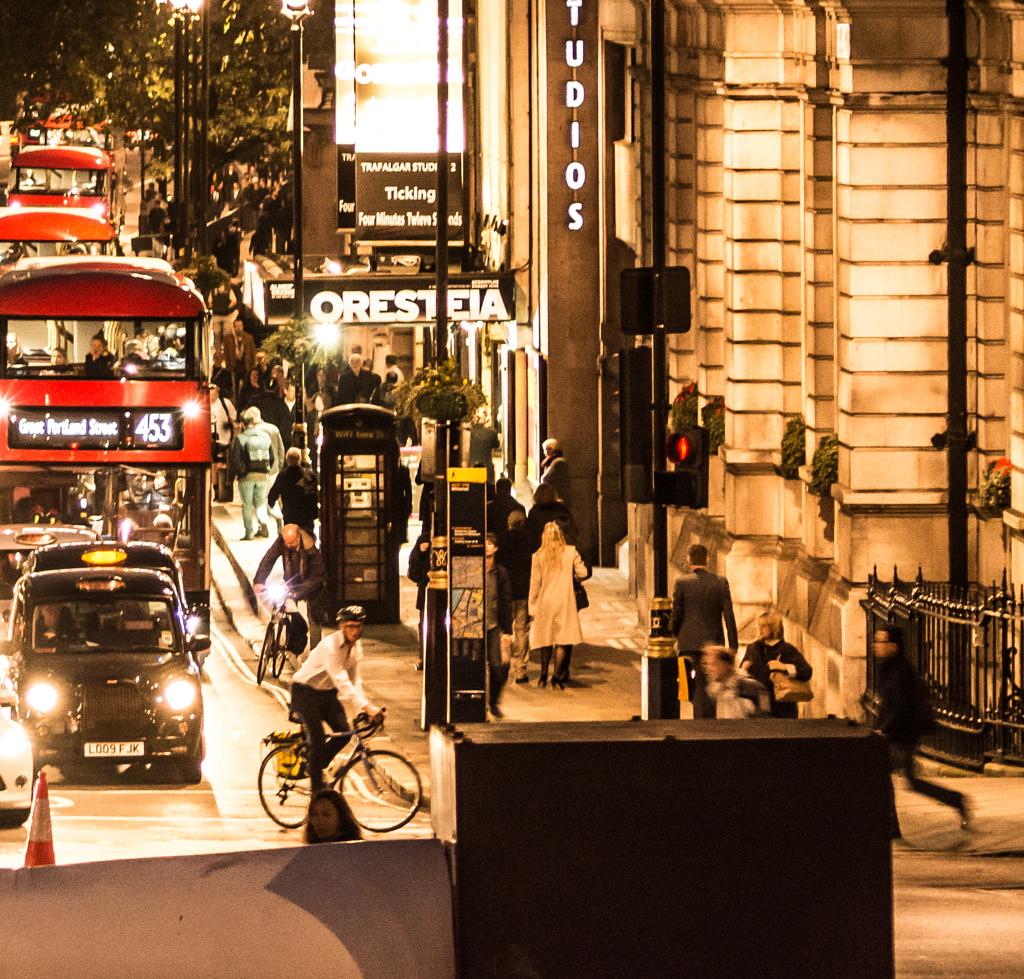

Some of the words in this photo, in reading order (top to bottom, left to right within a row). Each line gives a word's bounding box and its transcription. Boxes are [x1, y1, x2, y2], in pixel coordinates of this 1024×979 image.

[361, 162, 411, 173] TRAFALGAR
[412, 162, 438, 173] STUDI
[450, 162, 457, 173] 2
[384, 186, 437, 204] Ticking
[338, 199, 355, 213] Four
[358, 211, 375, 226] Four
[376, 211, 405, 226] Minutes
[432, 211, 463, 226] Snds
[310, 289, 510, 322] ORESTEIA
[134, 412, 173, 443] 453
